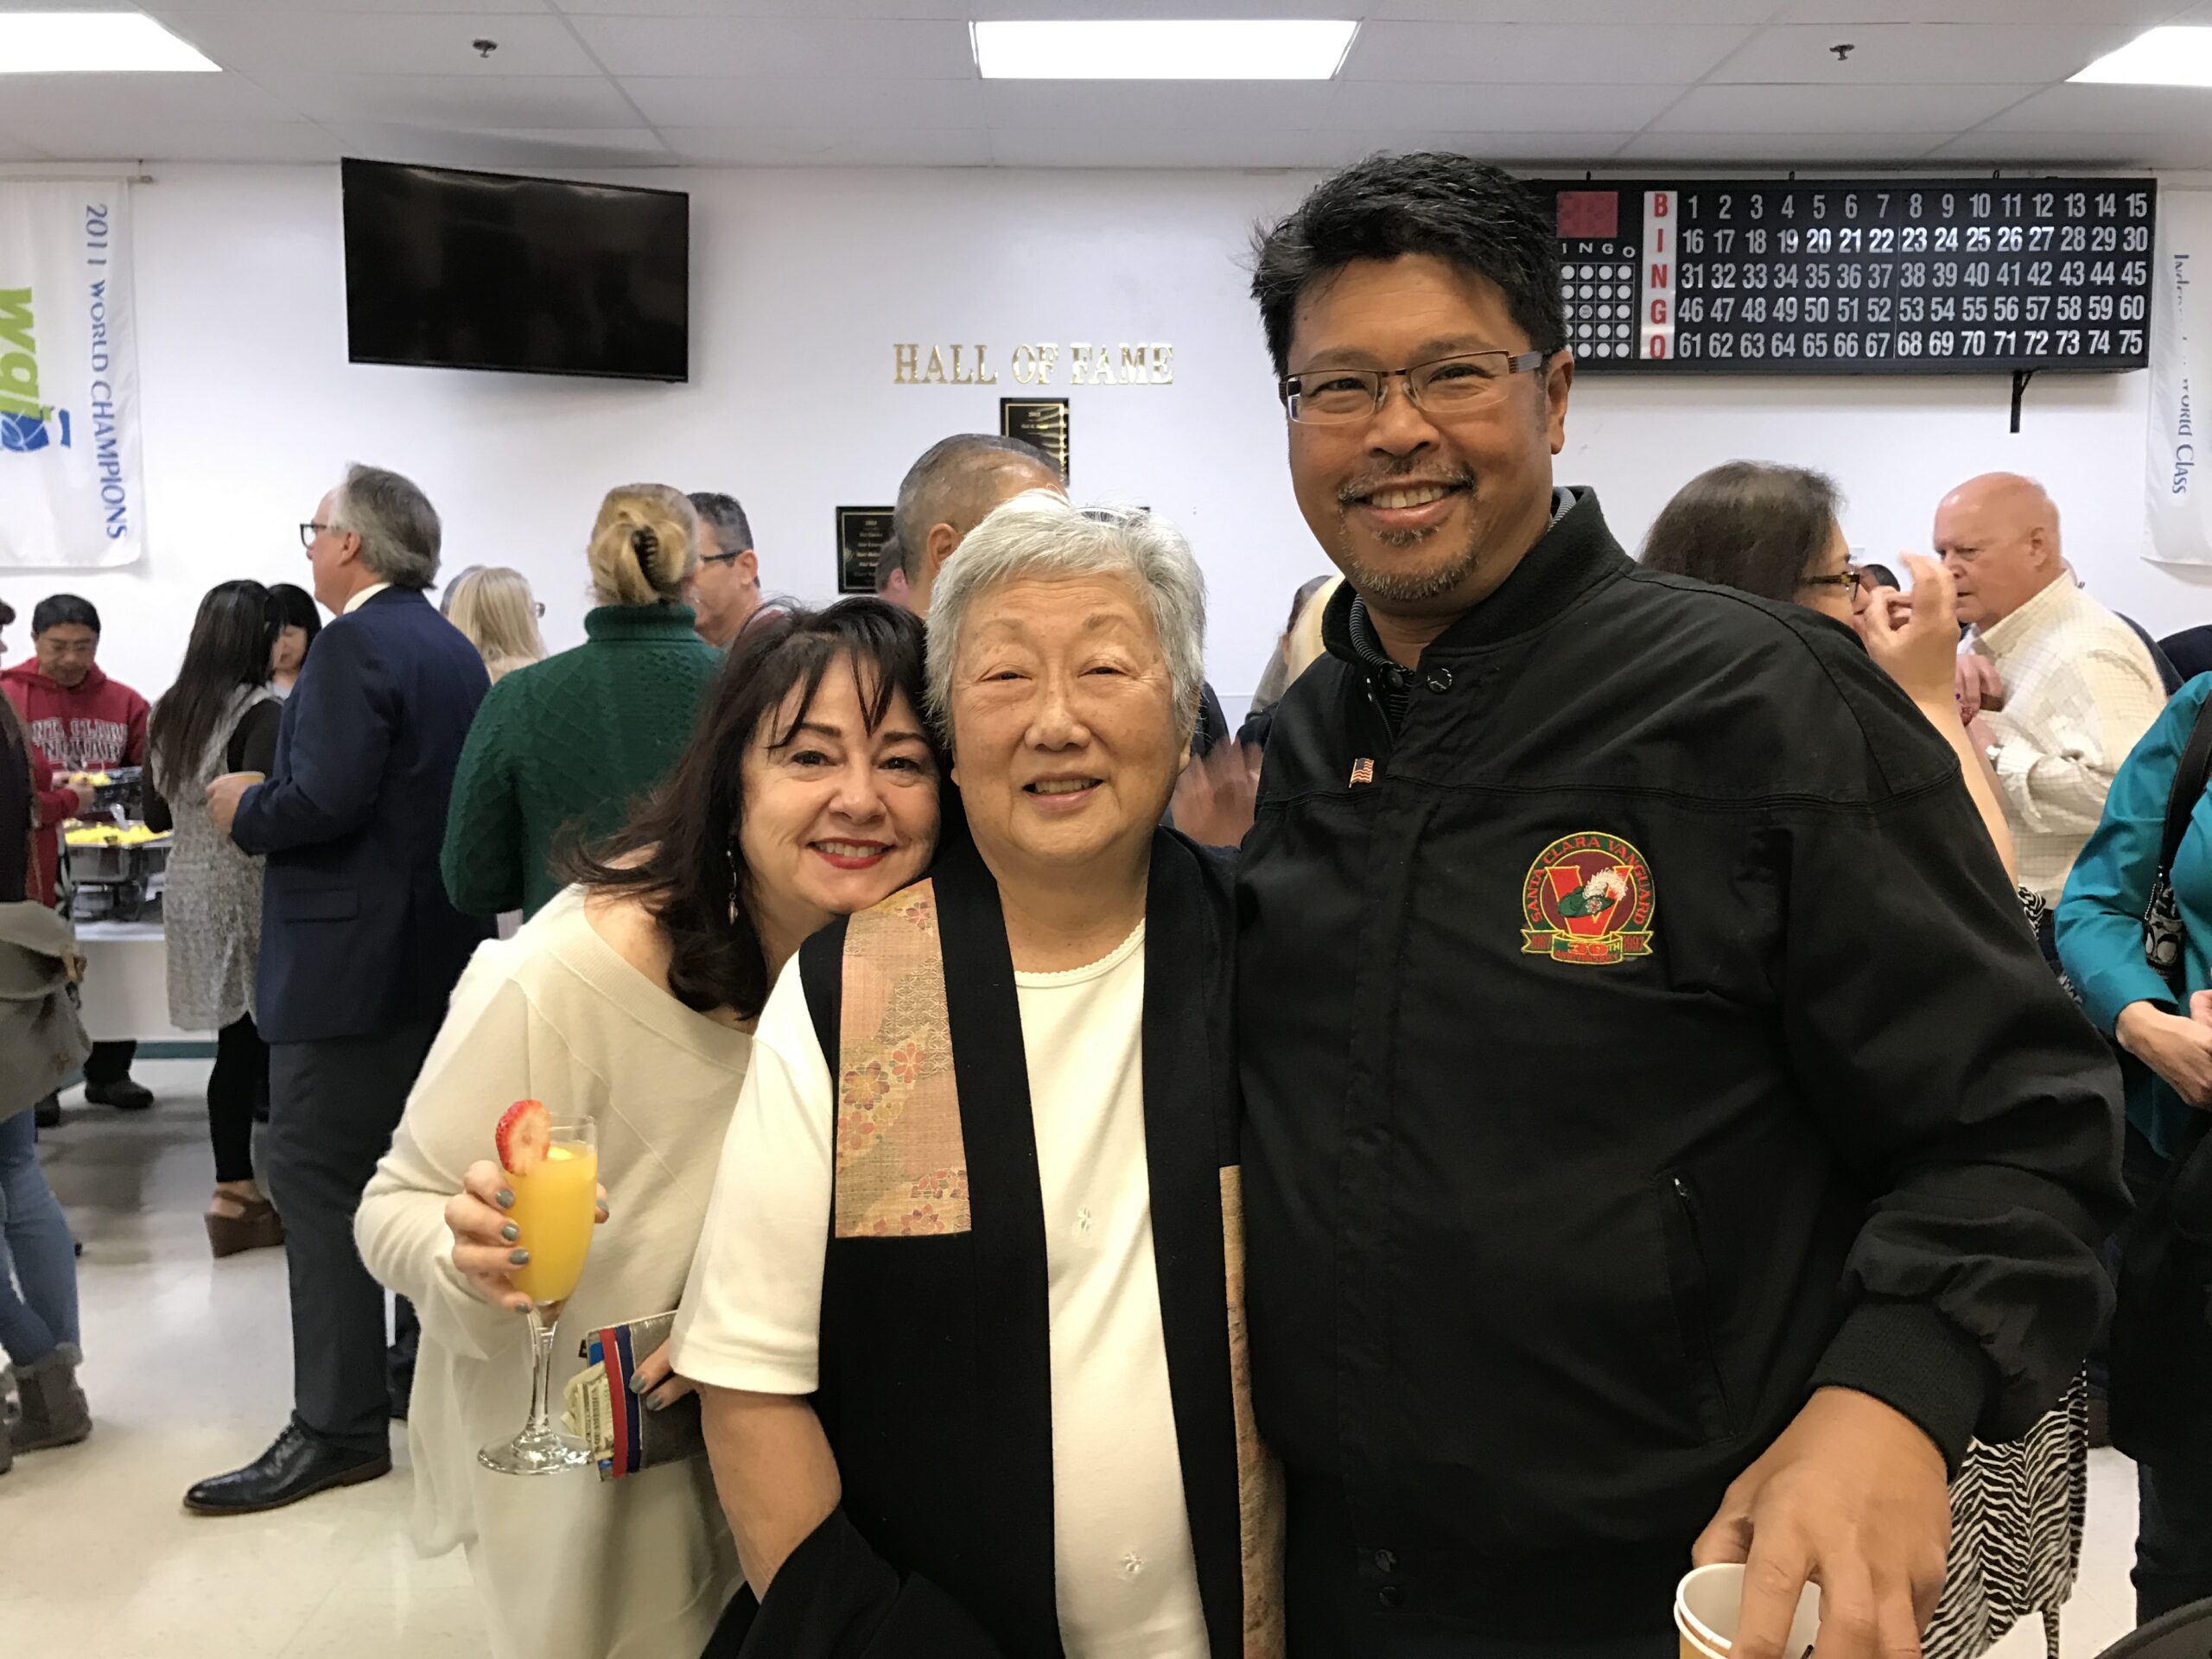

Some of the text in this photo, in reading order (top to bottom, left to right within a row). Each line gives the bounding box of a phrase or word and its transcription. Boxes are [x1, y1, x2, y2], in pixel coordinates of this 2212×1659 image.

[1688, 193, 2147, 219] 1 2 3 4 5 6 7 8 9 10 11 12 13 14 15
[1561, 242, 1636, 258] INGO
[1682, 226, 2148, 254] 16 17 18 19 20 21 22 23 24 25 26 27 28 29 30
[1681, 261, 2146, 289] 31 32 33 34 35 36 37 38 39 40 41 42 43 44 45
[1678, 295, 2145, 322] 46 47 48 49 50 51 52 53 54 55 56 57 58 59 60
[1680, 329, 2142, 358] 61 62 63 64 65 66 67 68 69 70 71 72 73 74 75
[86, 203, 127, 540] 2011 WORLD CHAMPIONS
[893, 343, 1173, 385] HALL OF FAME
[1527, 836, 1651, 925] SANTA CLARA VANGUARD
